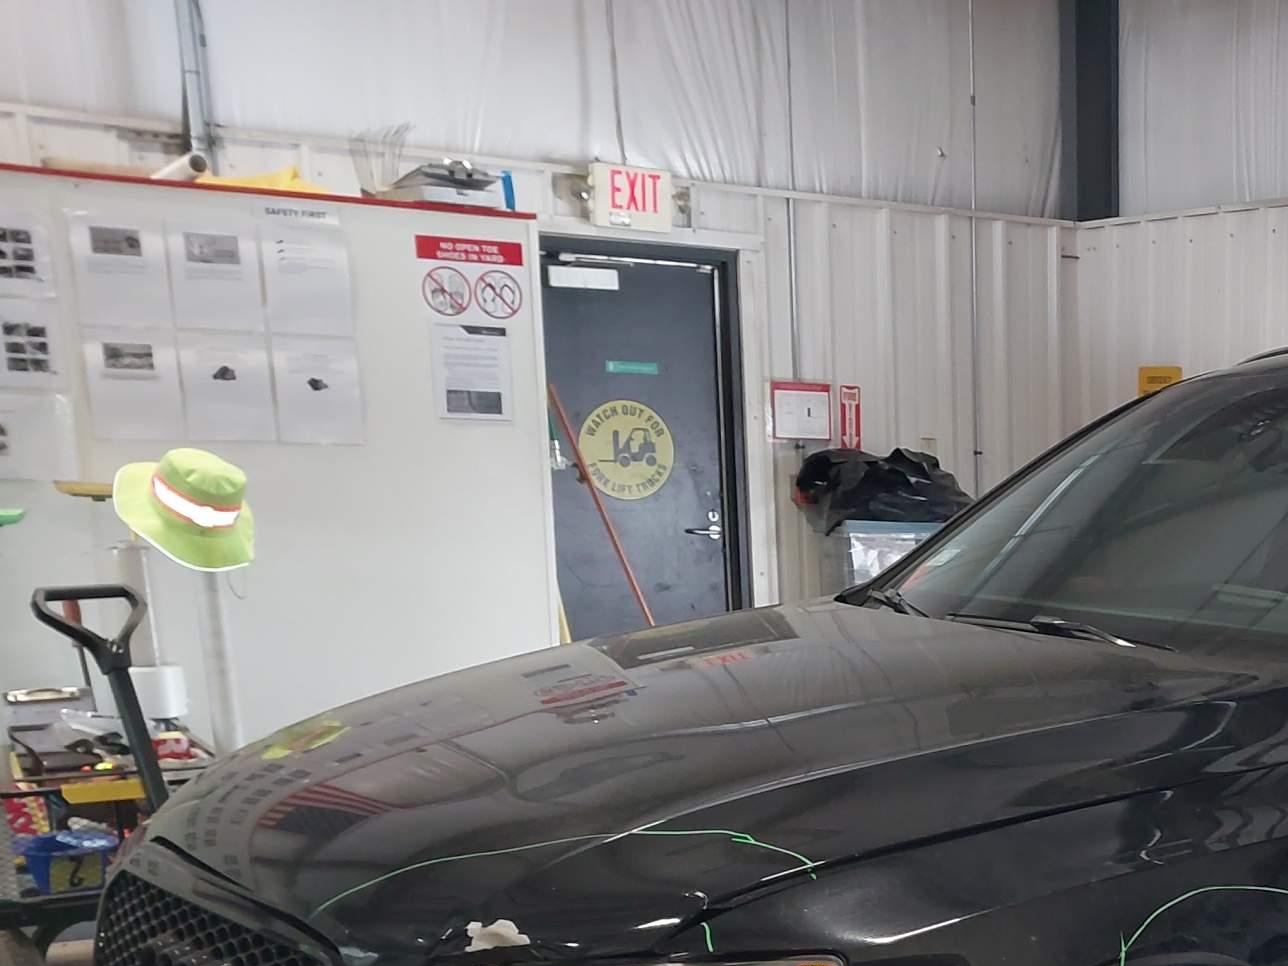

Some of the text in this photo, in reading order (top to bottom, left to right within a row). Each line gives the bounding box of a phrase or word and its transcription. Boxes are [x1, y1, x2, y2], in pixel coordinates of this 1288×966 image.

[610, 169, 661, 213] EXIT
[264, 207, 299, 217] SAFETY
[454, 242, 480, 253] OPEN
[585, 404, 665, 437] WATCH OUT FOR
[589, 462, 668, 494] FORK LIFT TRUCKS
